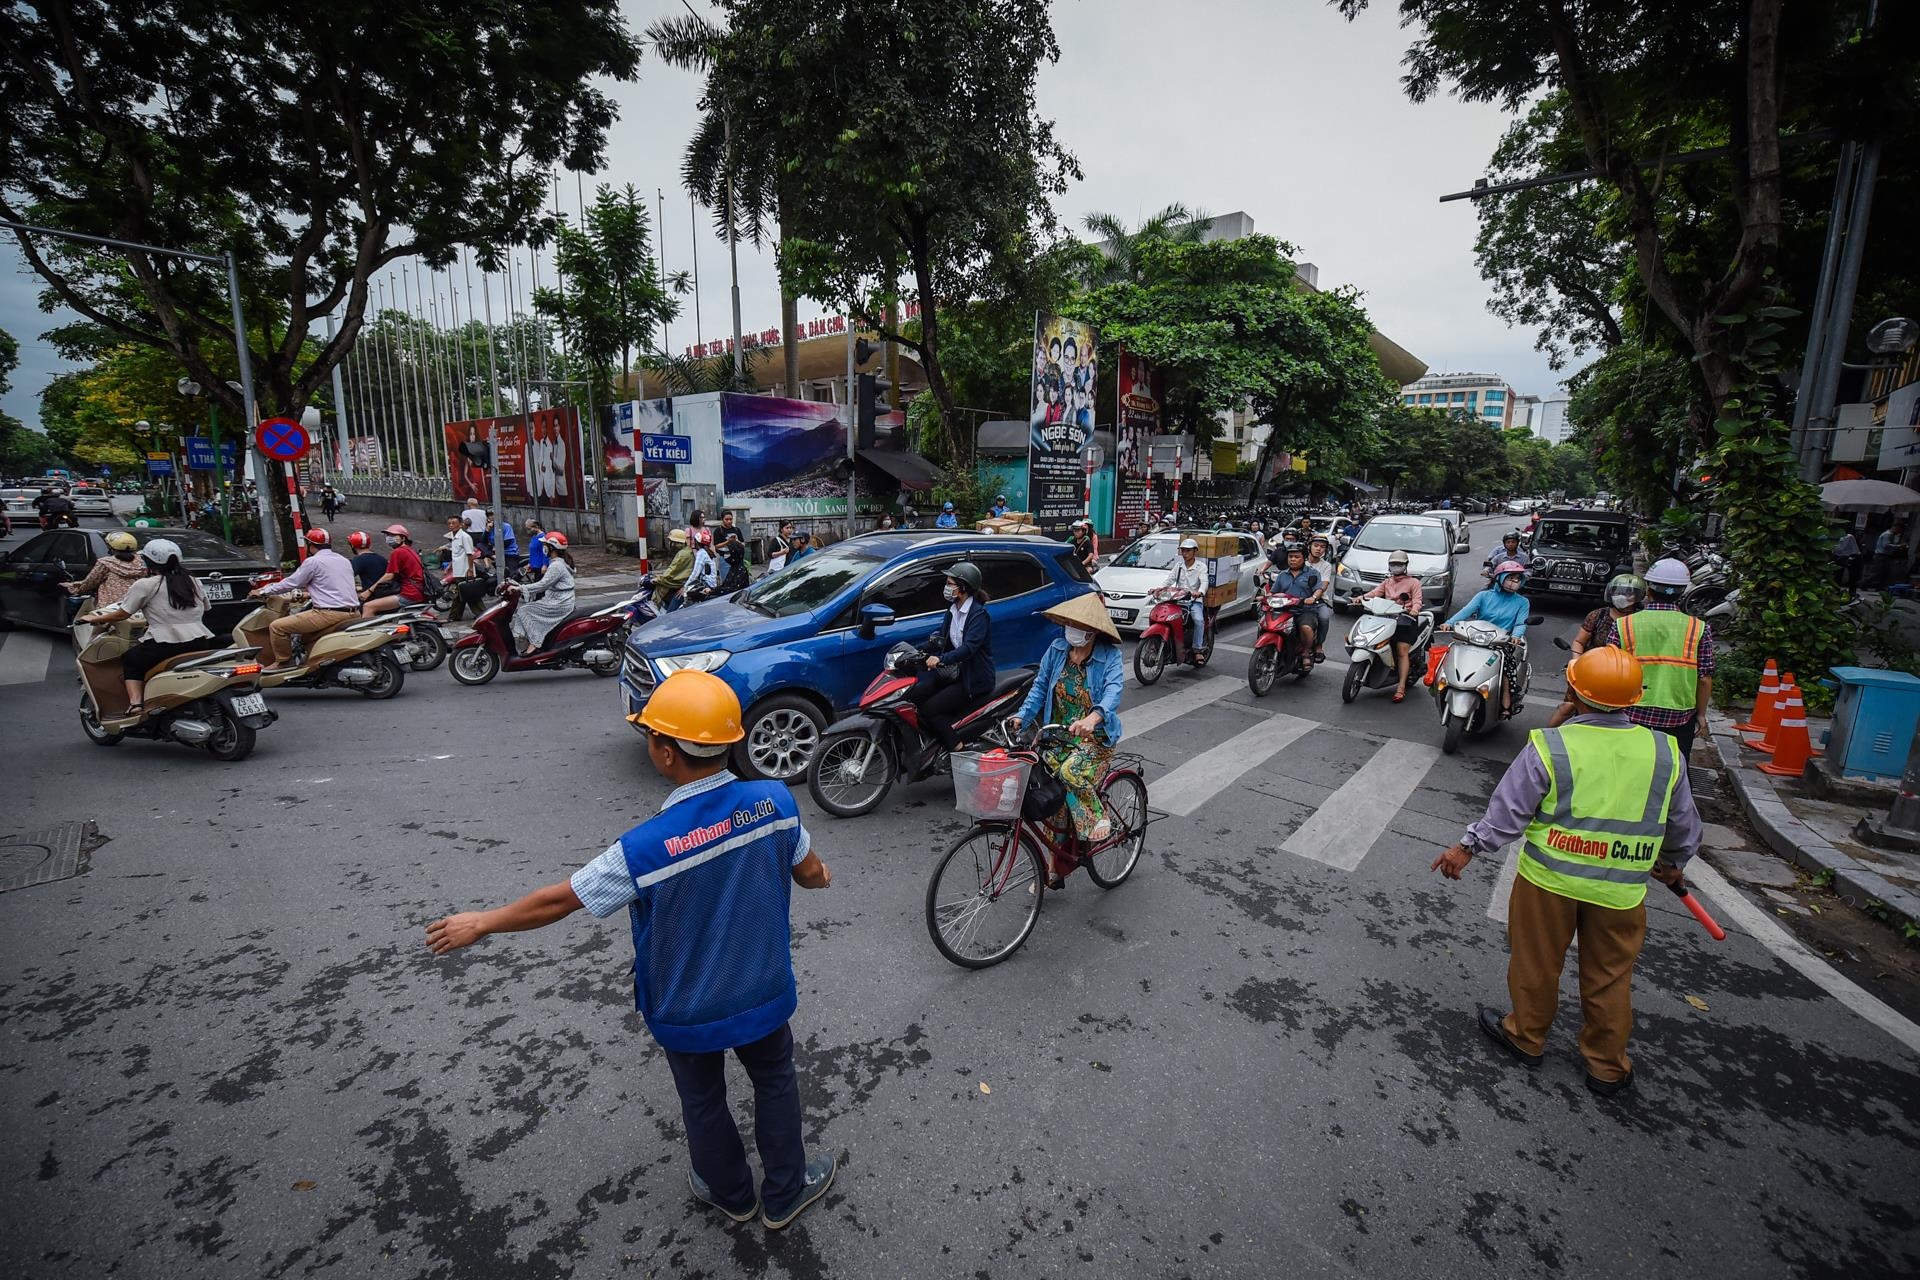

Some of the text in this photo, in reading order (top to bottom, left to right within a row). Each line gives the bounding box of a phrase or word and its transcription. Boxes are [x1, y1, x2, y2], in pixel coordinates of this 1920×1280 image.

[663, 439, 677, 447] PHỐ
[198, 452, 227, 464] THÁG
[646, 444, 687, 459] YẾT KIÊU
[209, 583, 225, 592] 29A
[664, 798, 776, 857] Vietthang Co.,Ltd
[1546, 827, 1655, 863] Vietthang Co.,Ltd
